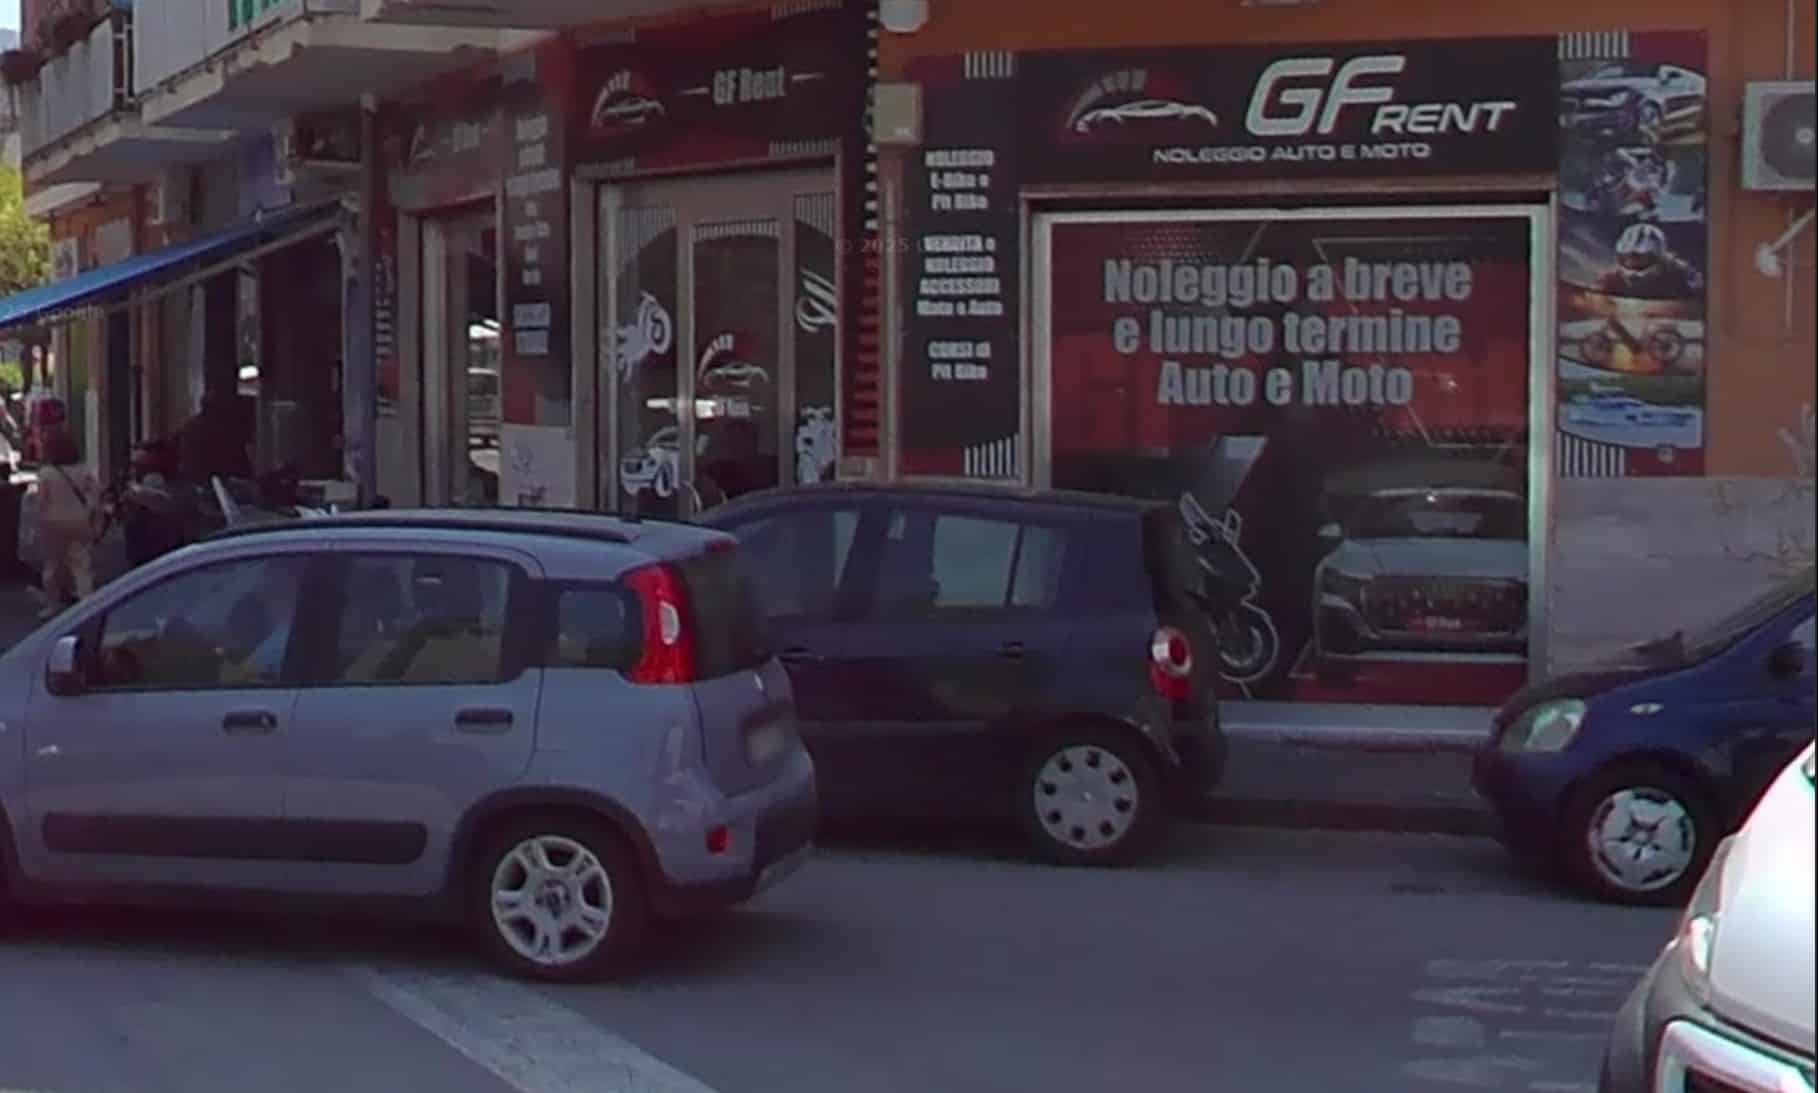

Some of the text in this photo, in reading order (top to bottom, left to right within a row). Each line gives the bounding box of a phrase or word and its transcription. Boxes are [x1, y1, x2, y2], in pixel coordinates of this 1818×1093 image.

[1245, 55, 1516, 136] GF RENT
[1152, 142, 1431, 163] NOLEGGIO AUTO E MOTO
[1104, 256, 1472, 307] Noleggio a breve
[1114, 309, 1461, 358] e lungo termine
[1157, 360, 1414, 406] Auto e Moto
